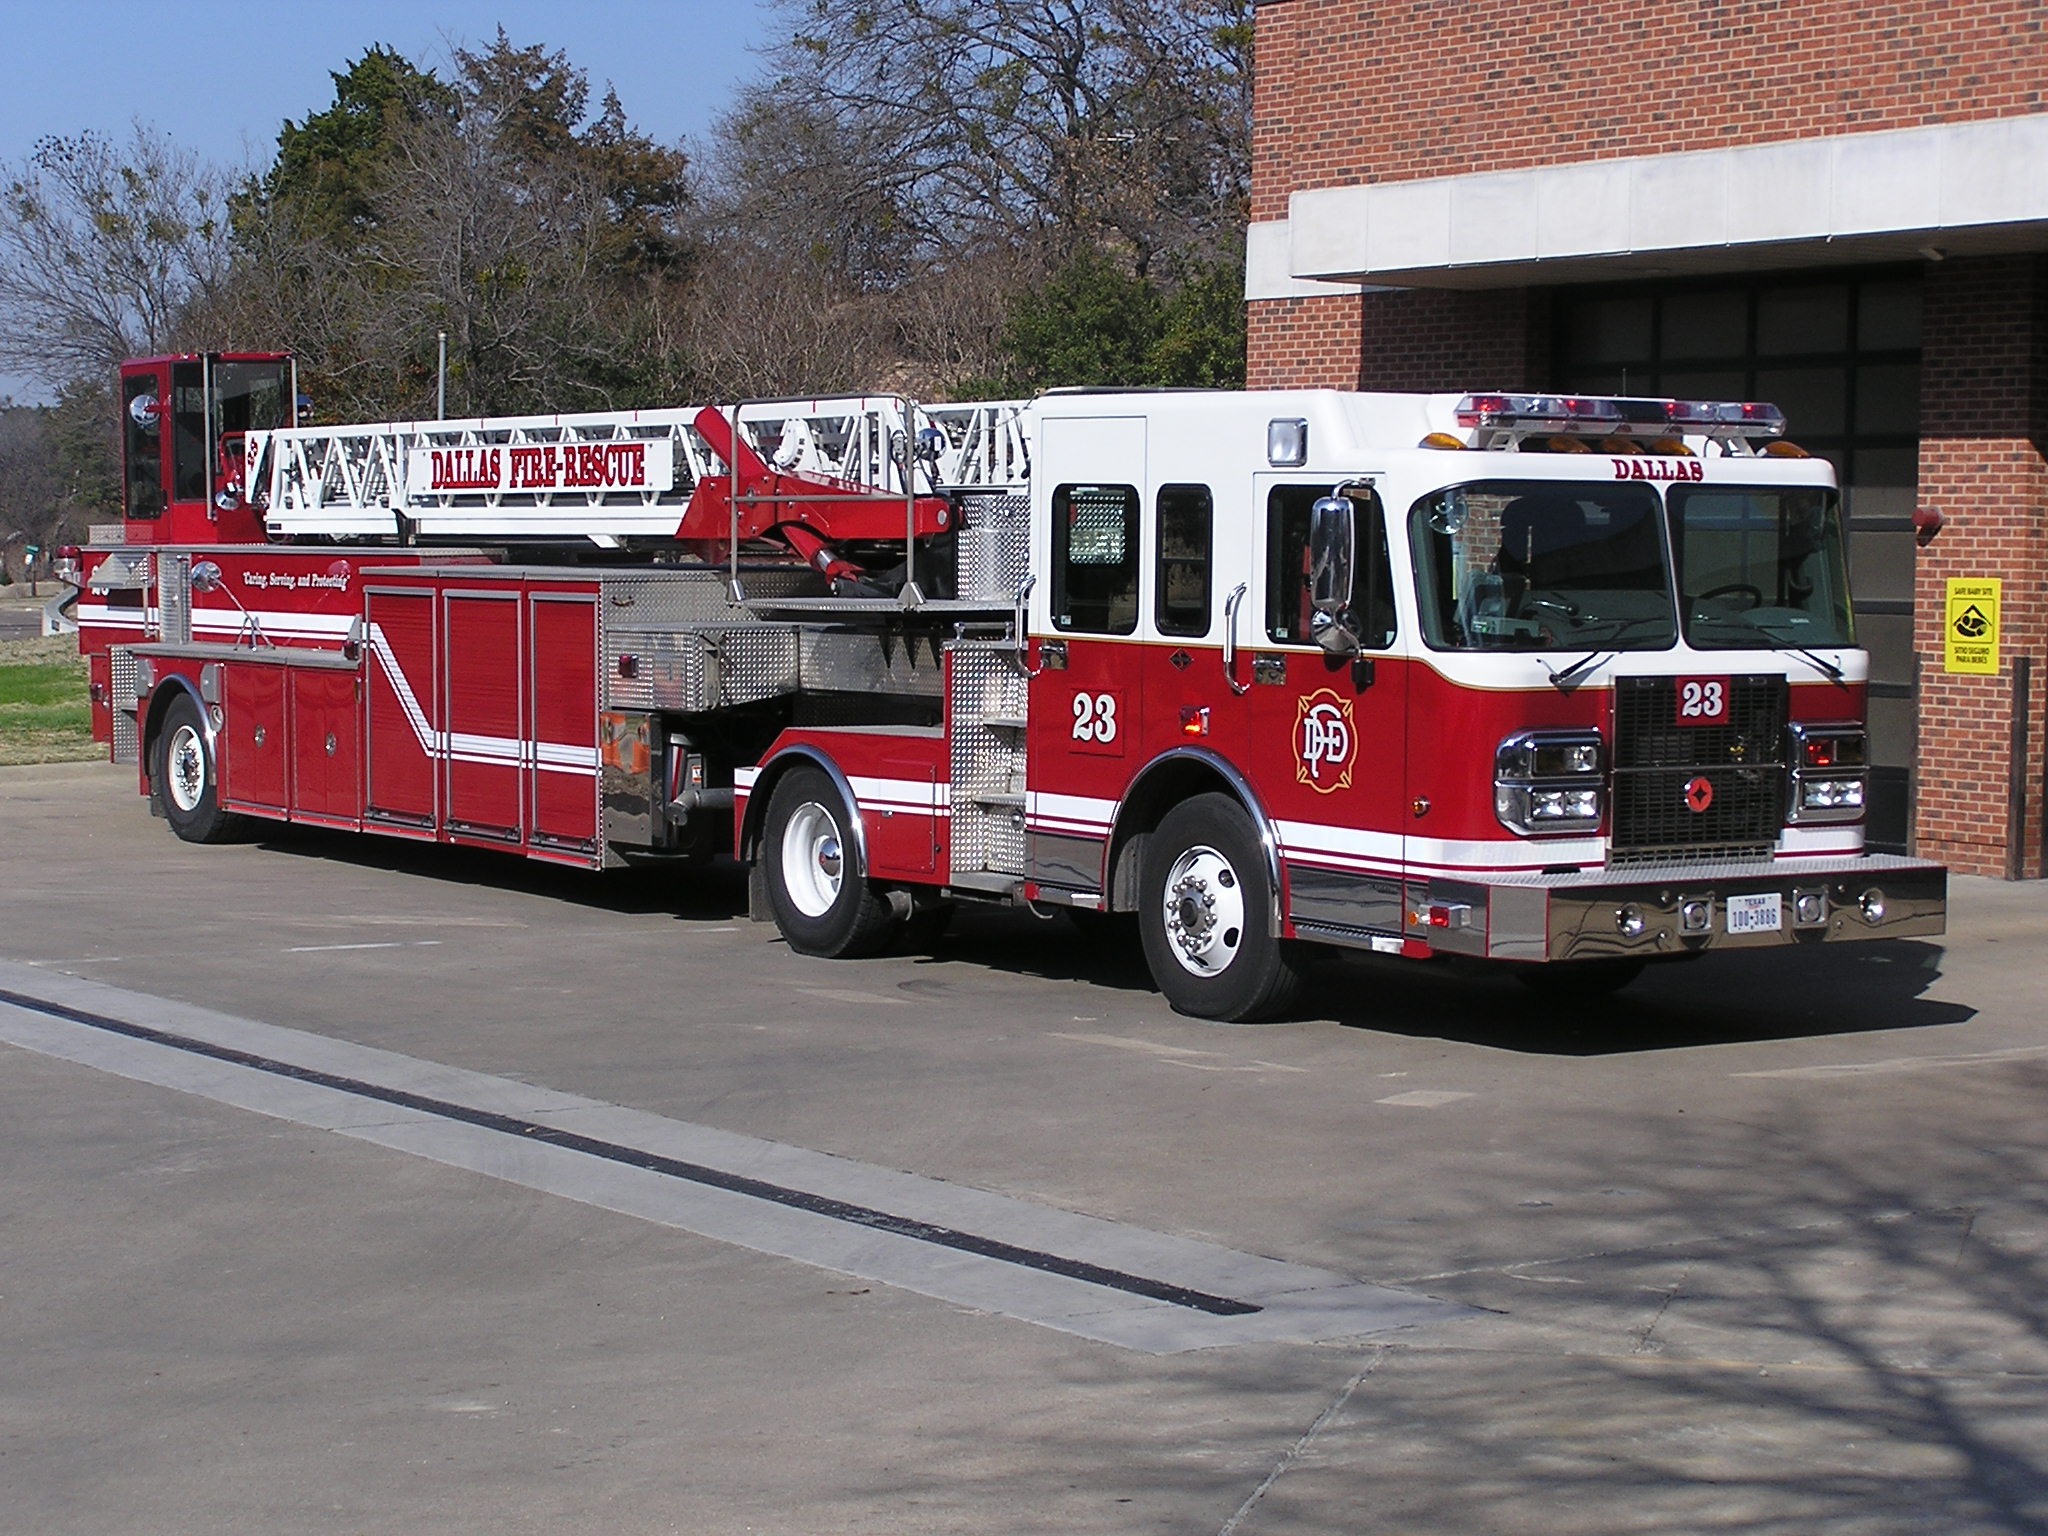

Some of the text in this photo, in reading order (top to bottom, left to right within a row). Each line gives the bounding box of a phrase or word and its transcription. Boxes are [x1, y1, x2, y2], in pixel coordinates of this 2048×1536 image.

[431, 443, 645, 490] DALLAS FIRE-RESCUE
[1610, 458, 1704, 481] DALLAS
[297, 573, 311, 587] and
[1682, 681, 1723, 717] 23
[1072, 691, 1117, 744] 23
